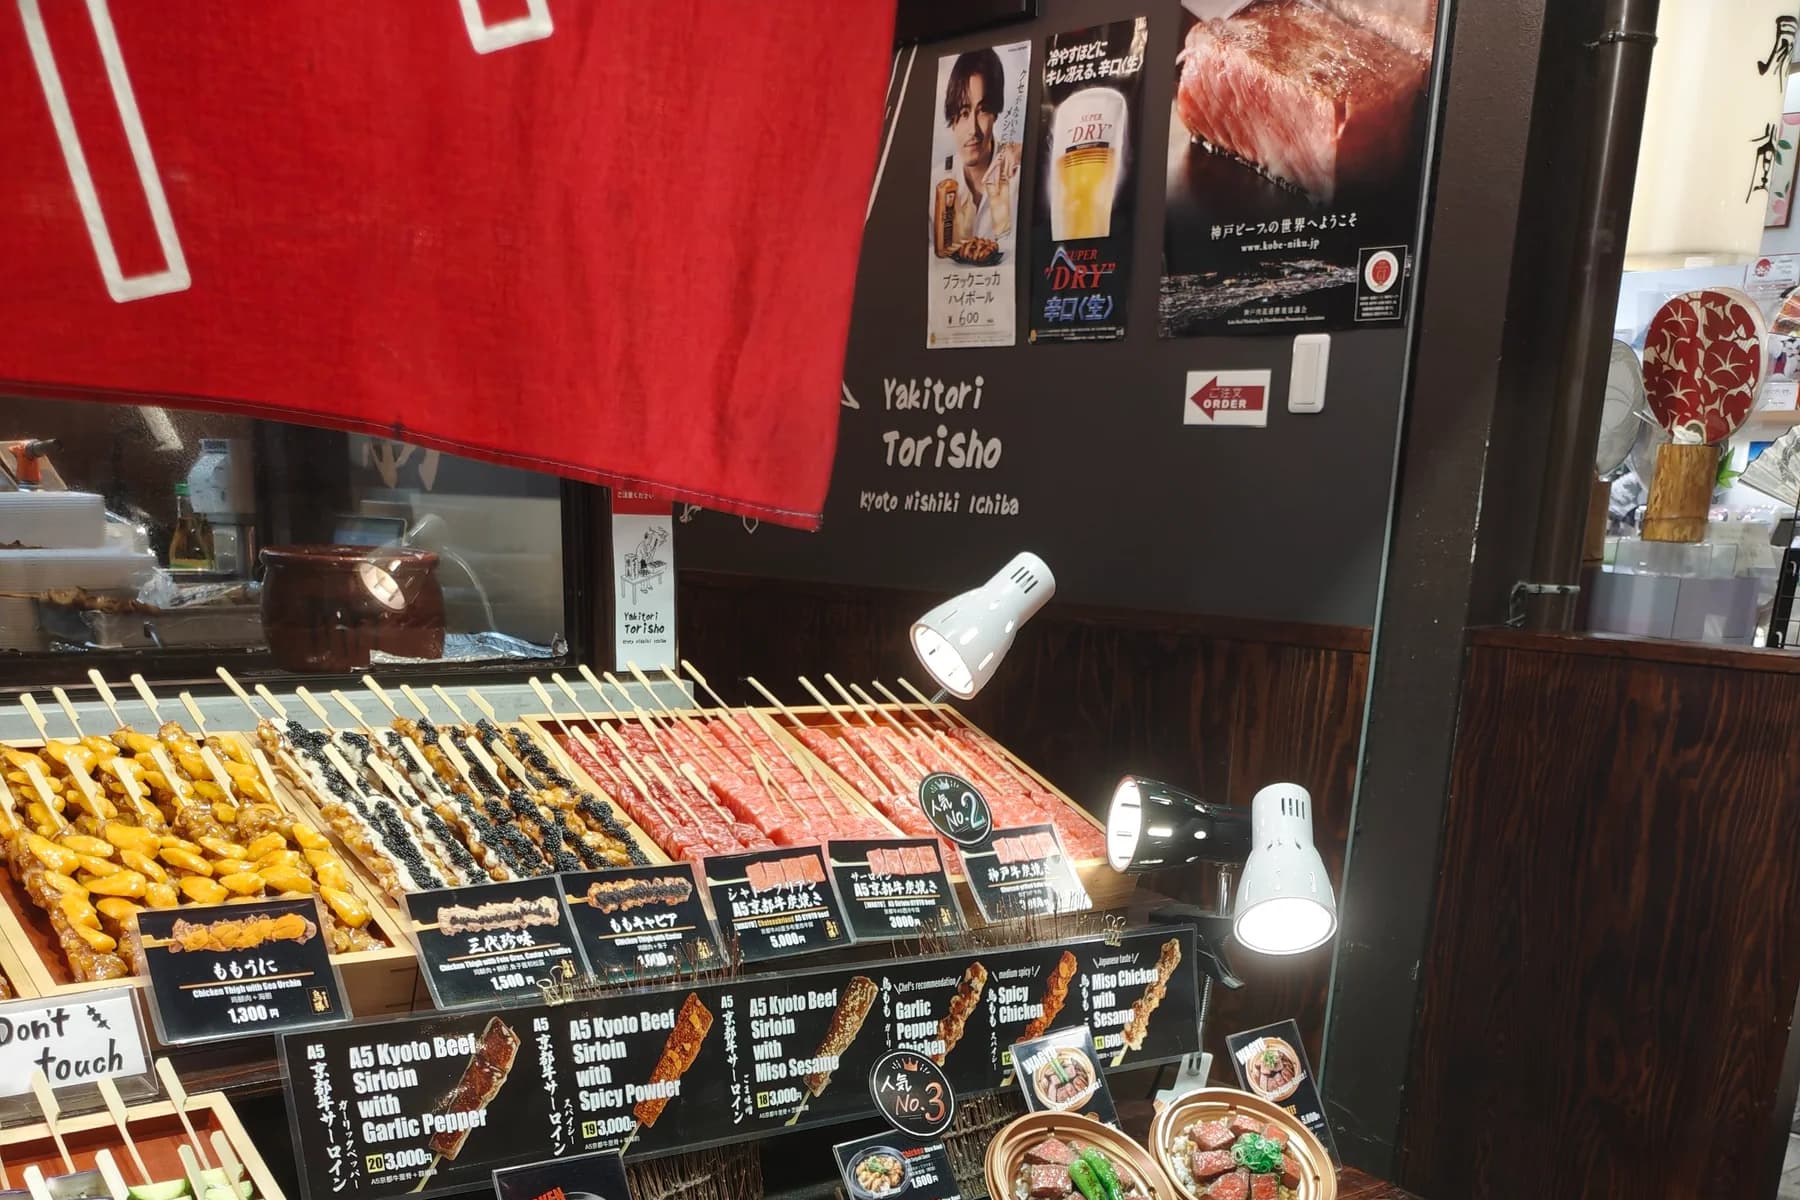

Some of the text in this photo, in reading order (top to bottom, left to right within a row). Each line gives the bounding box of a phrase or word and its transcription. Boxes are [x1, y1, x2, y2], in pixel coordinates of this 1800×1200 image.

[1047, 40, 1108, 67] 冷やすほどに
[1211, 212, 1358, 241] 神戸ビーフの世界へようこそ
[1241, 238, 1320, 252] www.kobe-niku.jp
[943, 271, 1000, 289] ブラックニッカ
[948, 291, 994, 305] ハイボール
[883, 376, 984, 414] Yakitori
[1203, 399, 1247, 409] ORDER
[1209, 387, 1242, 398] ご注文
[883, 424, 1002, 469] Torisho
[624, 611, 658, 622] Yakitori
[624, 623, 665, 634] Torisho
[931, 793, 953, 817] 人気
[946, 791, 986, 832] No.2
[850, 872, 892, 881] サーロイン
[610, 913, 677, 933] ももキャビア
[468, 931, 535, 954] 三代珍味
[213, 957, 278, 981] ももうに
[1092, 968, 1159, 991] Miso Chicken
[193, 987, 225, 999] Chicken
[224, 985, 246, 997] Thigh
[246, 983, 262, 994] with
[262, 981, 277, 992] Sea
[998, 985, 1029, 1005] Spicy
[1093, 991, 1116, 1010] with
[750, 988, 838, 1018] A5 Kyoto Beef
[895, 999, 932, 1020] Garlic
[999, 1003, 1044, 1024] Chicken
[570, 1009, 675, 1042] A5 Kyoto Beef
[751, 1016, 796, 1039] Sirloin
[1093, 1008, 1135, 1029] Sesame
[897, 1020, 939, 1041] Pepper
[34, 1038, 123, 1083] touch
[349, 1033, 477, 1070] A5 Kyoto Beef
[572, 1040, 628, 1065] Sirloin
[753, 1040, 783, 1061] with
[576, 1065, 612, 1088] with
[755, 1055, 840, 1083] Miso Sesame
[353, 1068, 419, 1094] Sirloin
[881, 1074, 912, 1093] 人気
[357, 1094, 401, 1119] with
[578, 1080, 681, 1112] Spicy Powder
[895, 1081, 945, 1124] No.3
[362, 1108, 488, 1144] Garlic Pepper
[584, 1122, 596, 1136] 19
[368, 1155, 383, 1171] 20
